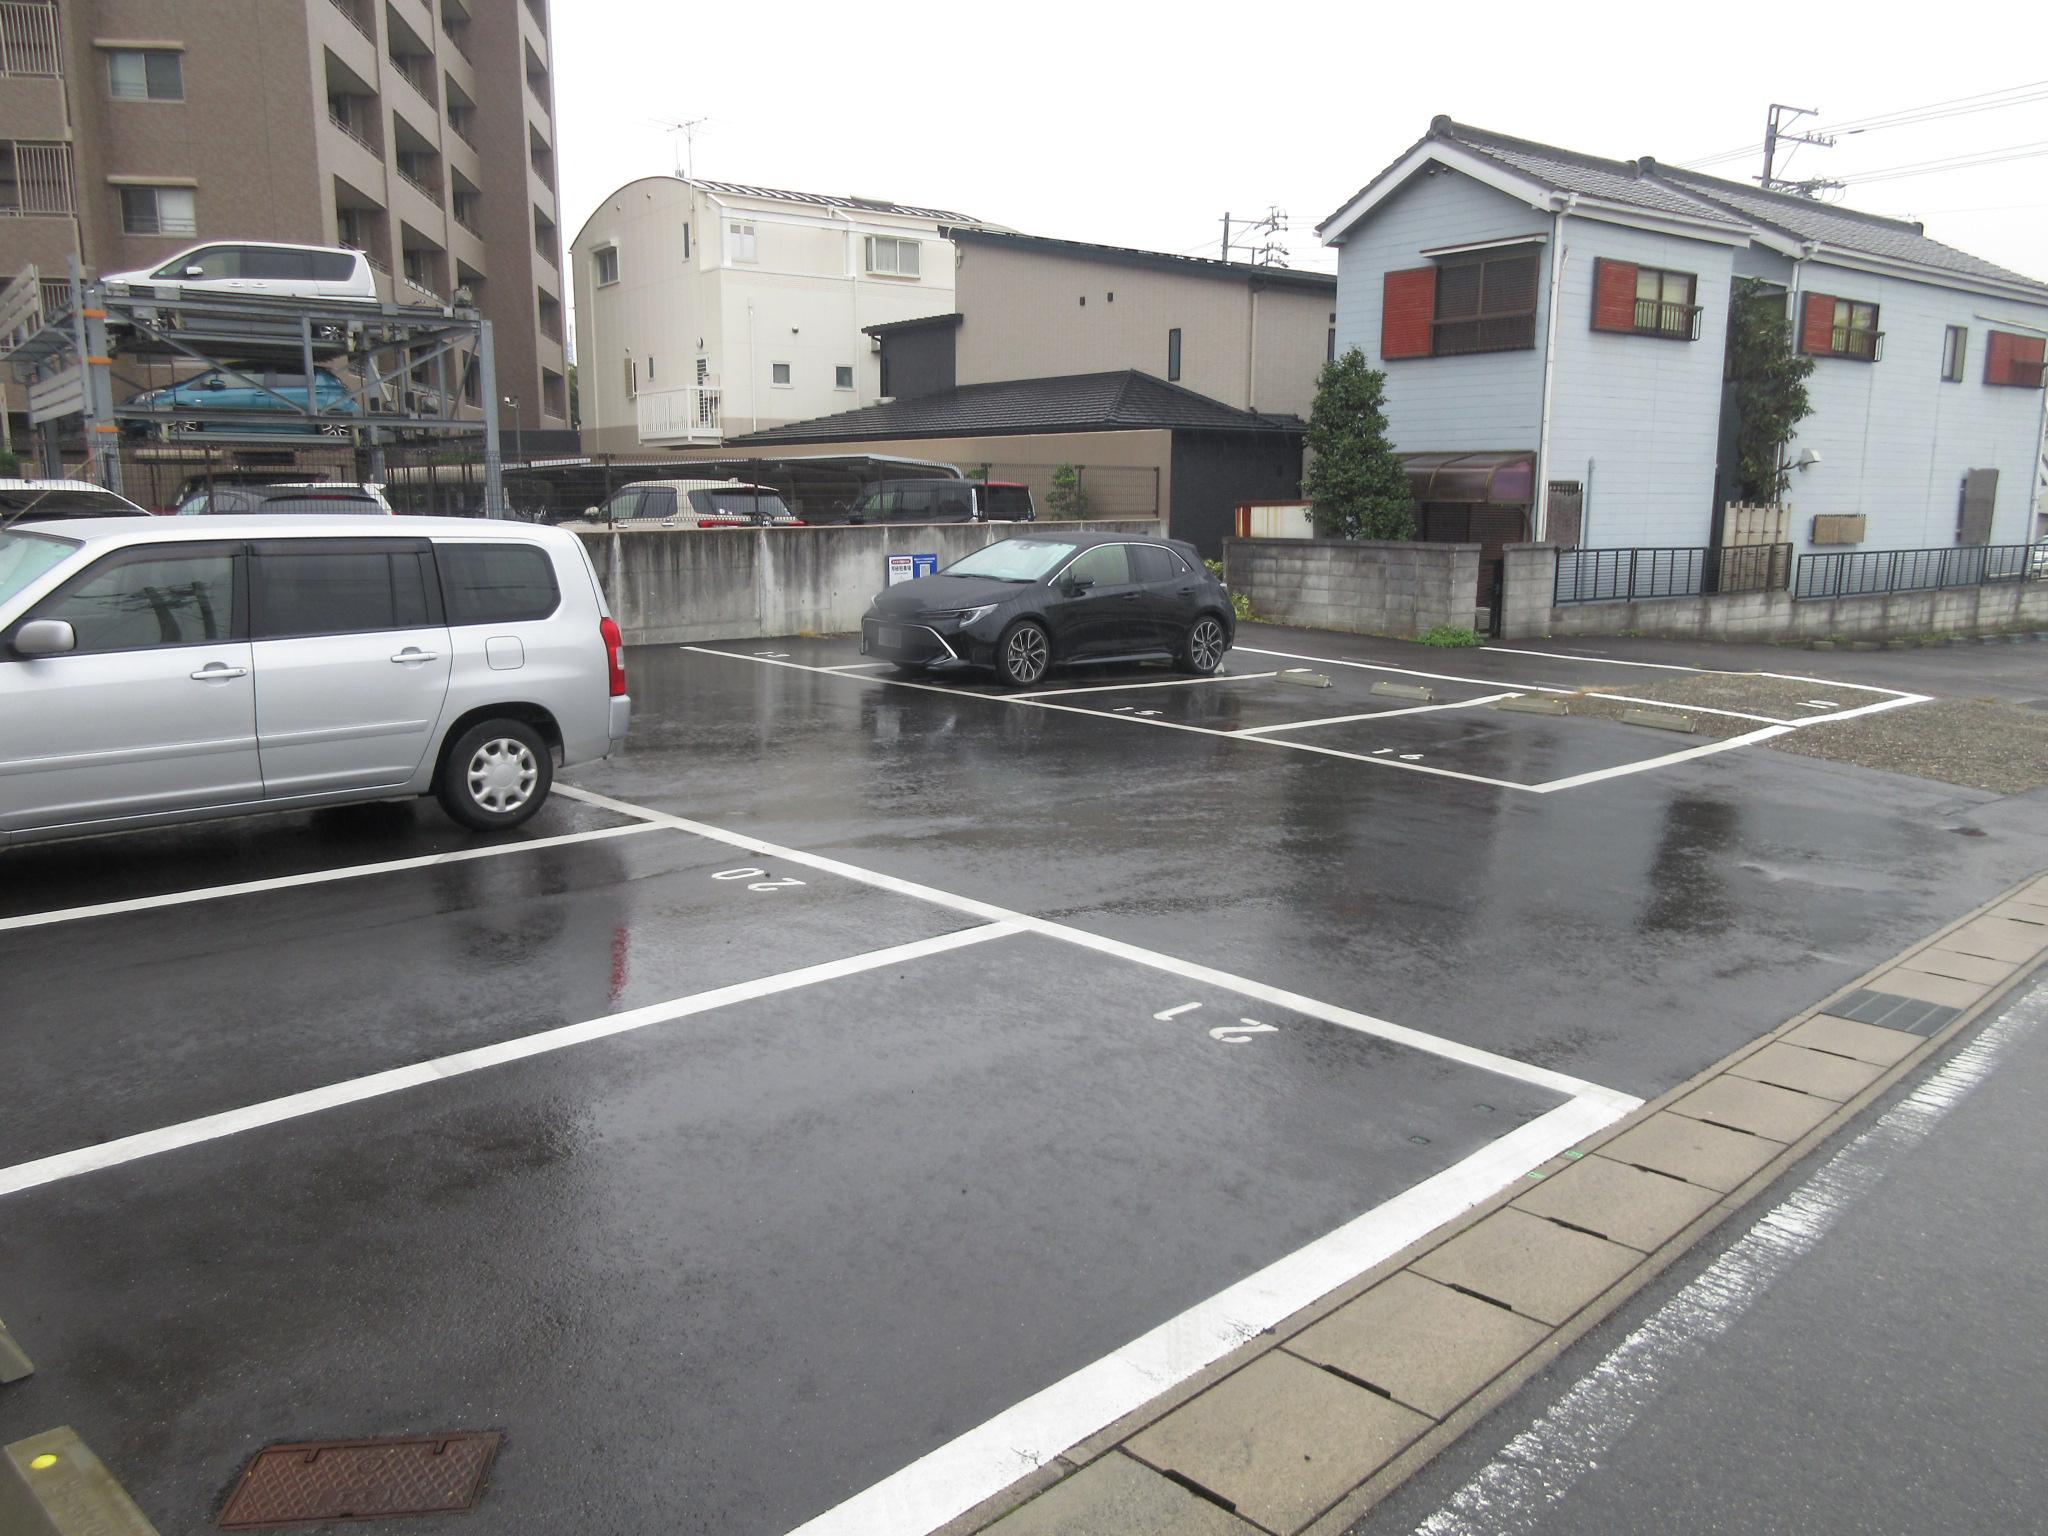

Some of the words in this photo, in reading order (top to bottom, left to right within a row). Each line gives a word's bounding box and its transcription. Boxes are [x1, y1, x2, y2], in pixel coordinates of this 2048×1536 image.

[1371, 747, 1424, 760] 16
[711, 867, 807, 891] 20
[1152, 1001, 1280, 1043] 21
